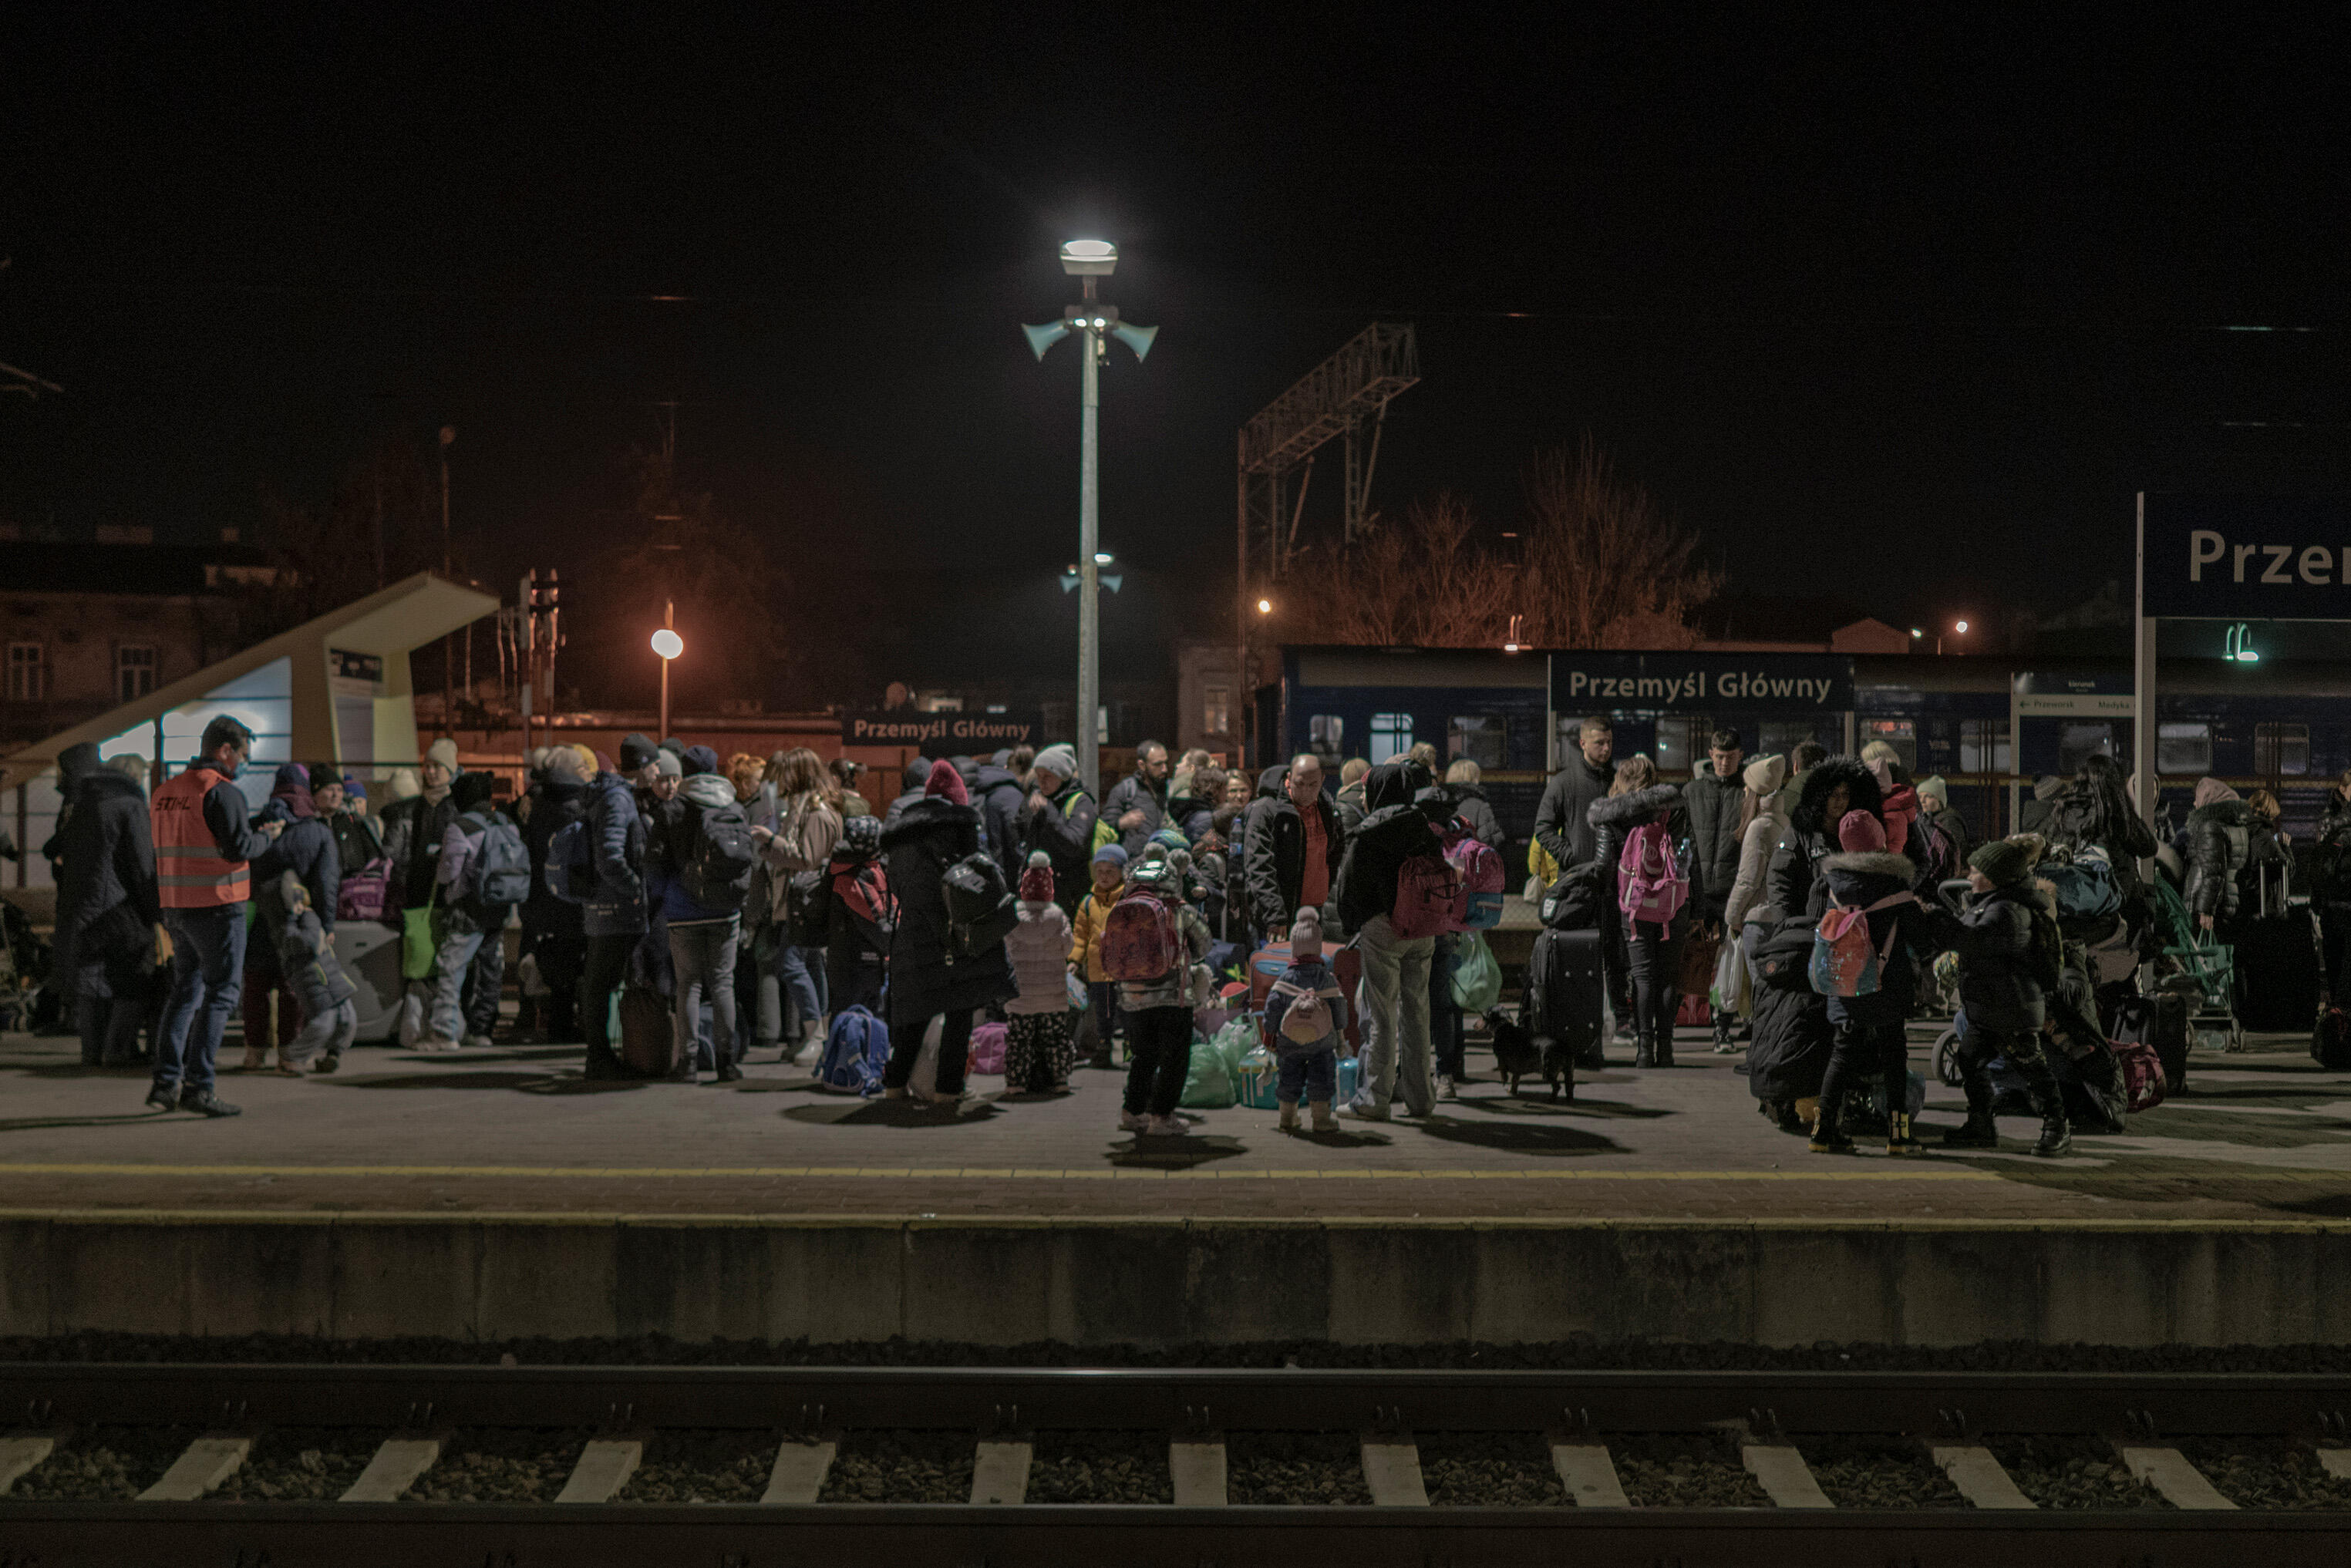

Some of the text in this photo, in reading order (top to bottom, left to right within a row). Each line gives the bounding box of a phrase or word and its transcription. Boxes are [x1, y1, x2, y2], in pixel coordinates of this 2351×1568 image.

[2190, 530, 2351, 585] Prze
[1570, 671, 1831, 704] Przemyśl Główny
[854, 718, 1031, 742] Przemyśl Główny
[155, 796, 190, 811] STIHL
